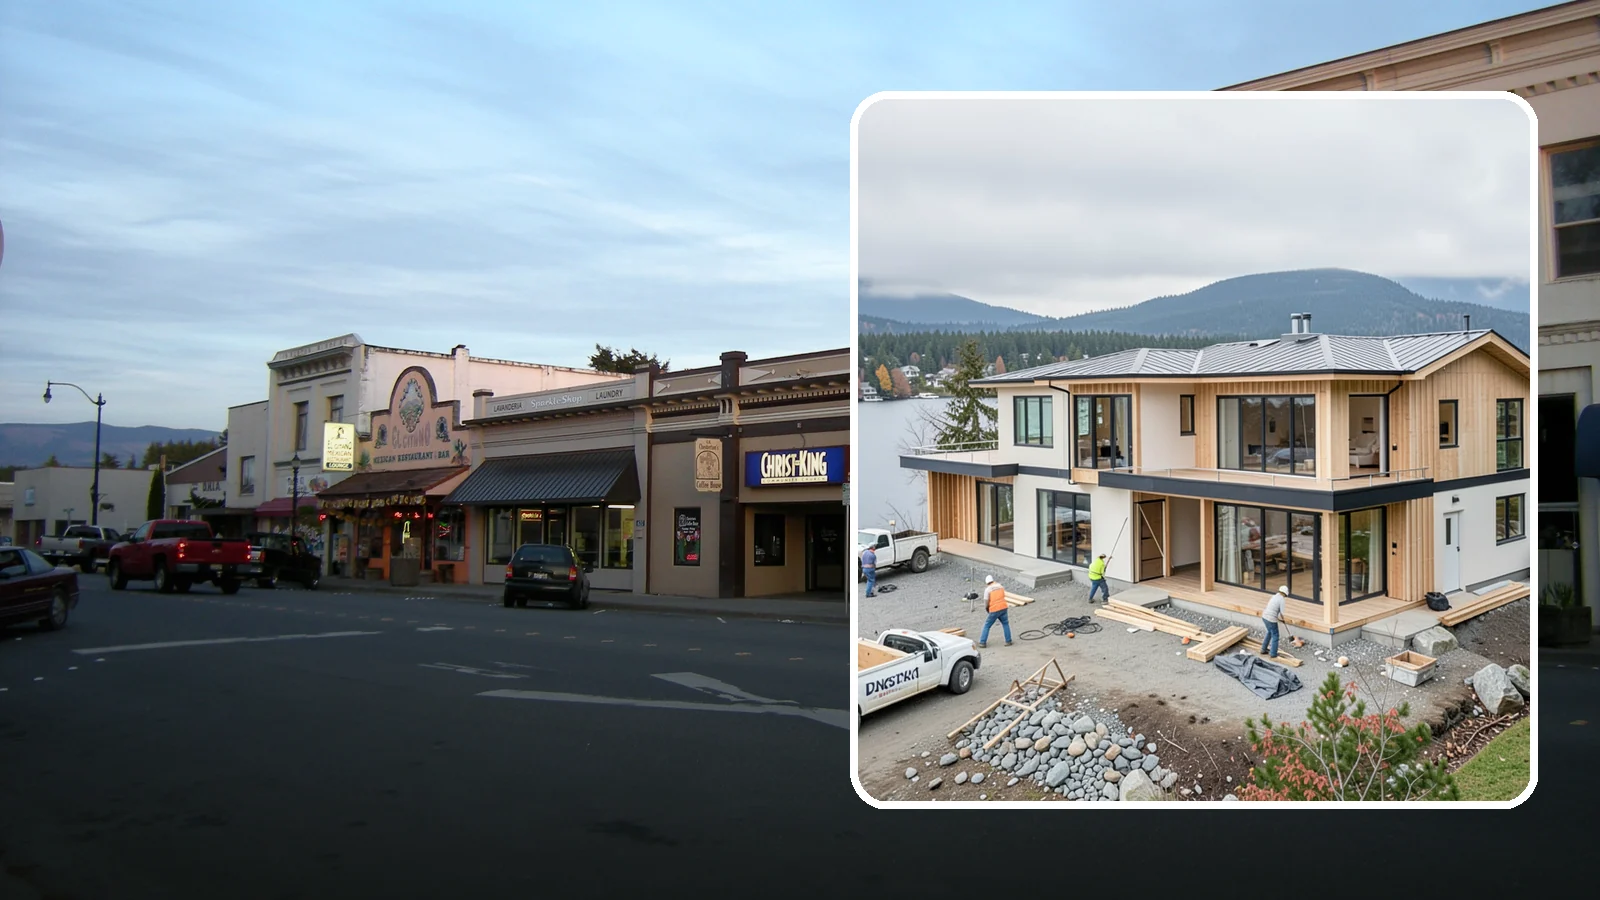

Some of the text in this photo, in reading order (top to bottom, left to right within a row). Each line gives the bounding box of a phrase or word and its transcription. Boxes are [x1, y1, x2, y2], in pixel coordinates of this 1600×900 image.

[562, 395, 582, 404] Shop
[595, 389, 624, 400] LAUNDRY
[494, 402, 523, 412] LAVANDERIA
[374, 455, 396, 464] MEXICAN
[398, 451, 433, 463] RESTAURANT
[438, 450, 450, 459] BAR
[760, 450, 828, 478] CHRIST KING
[696, 480, 722, 489] Coffee House
